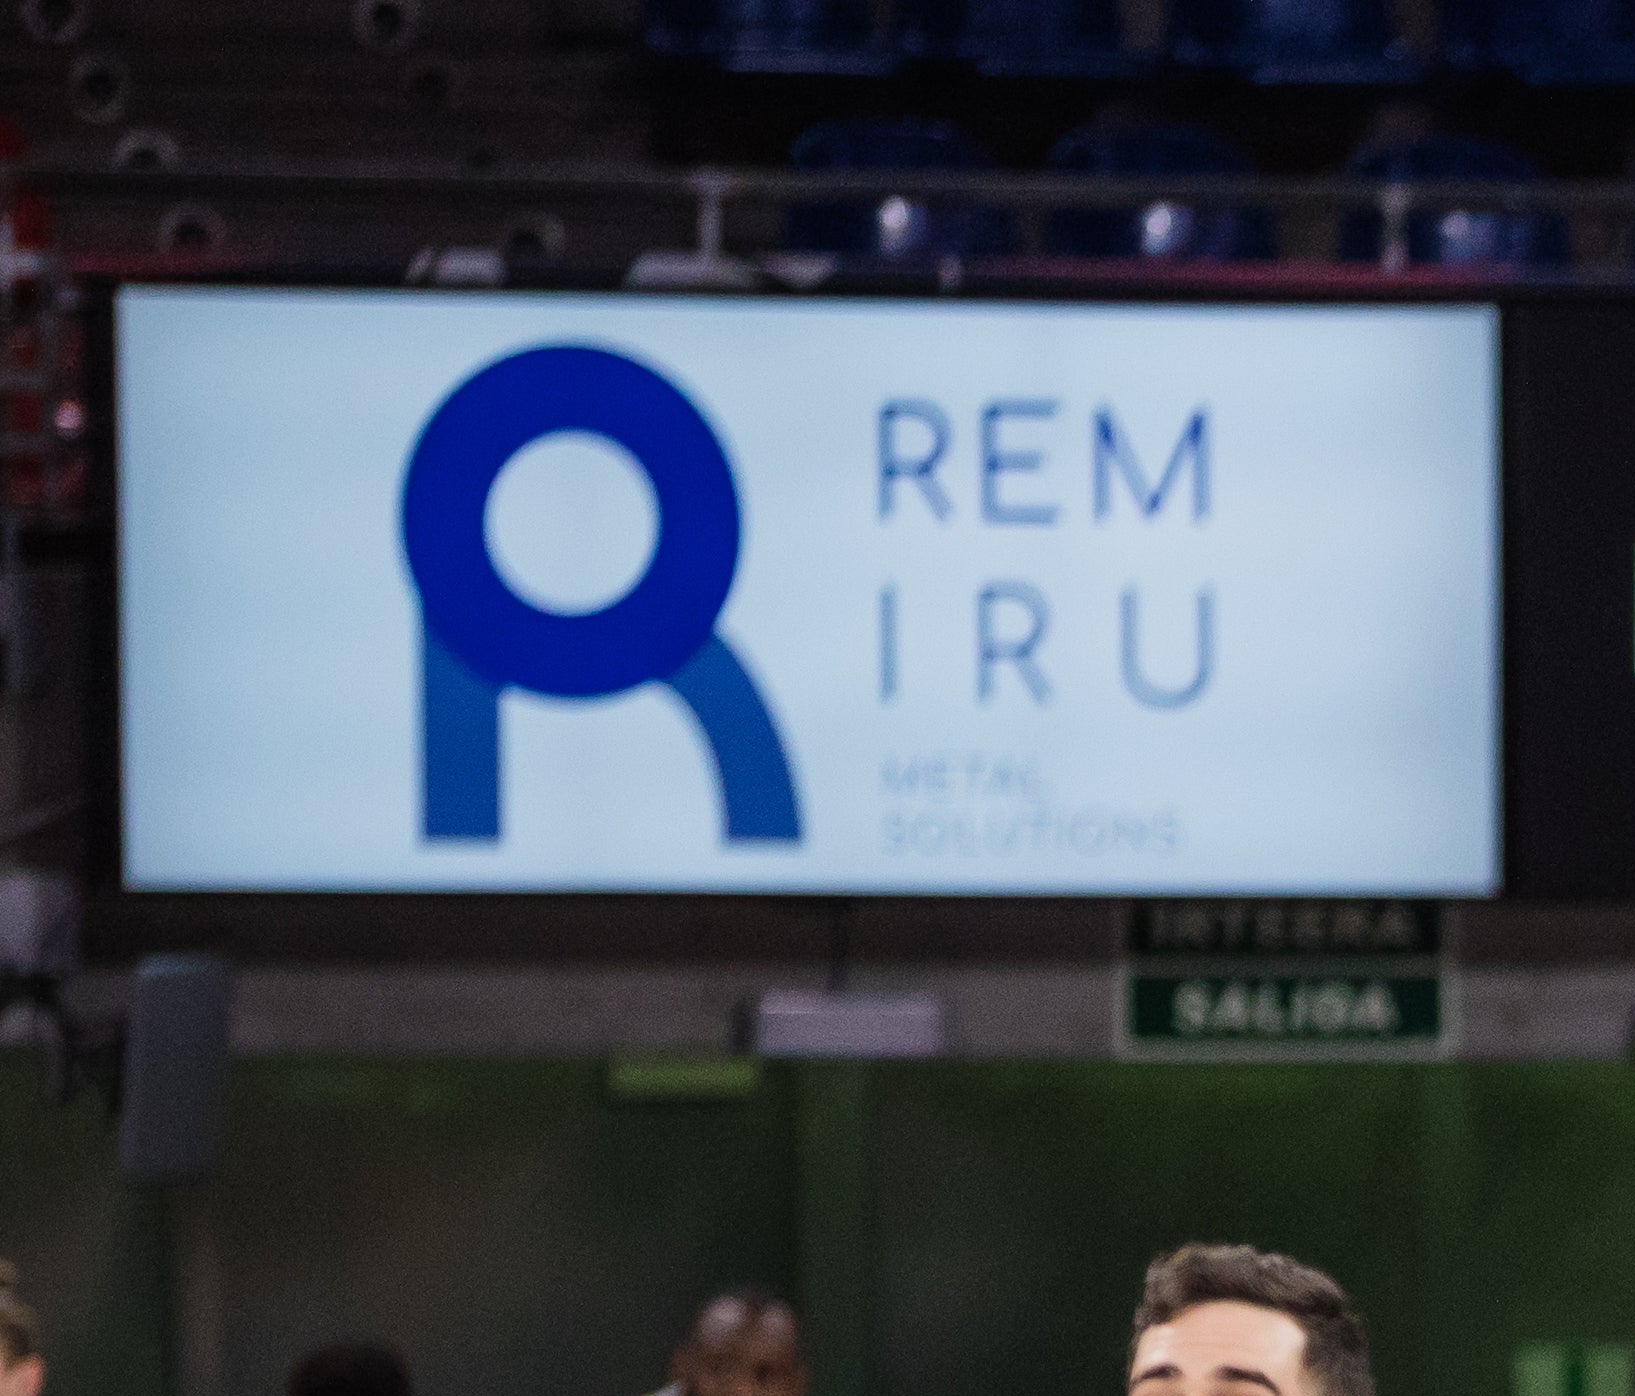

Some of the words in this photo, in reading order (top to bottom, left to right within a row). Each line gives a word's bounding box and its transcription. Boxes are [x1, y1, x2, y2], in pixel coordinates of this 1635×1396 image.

[876, 395, 1216, 526] REM
[878, 804, 1186, 858] SOLUTIONS
[1172, 981, 1401, 1032] SALIDA
